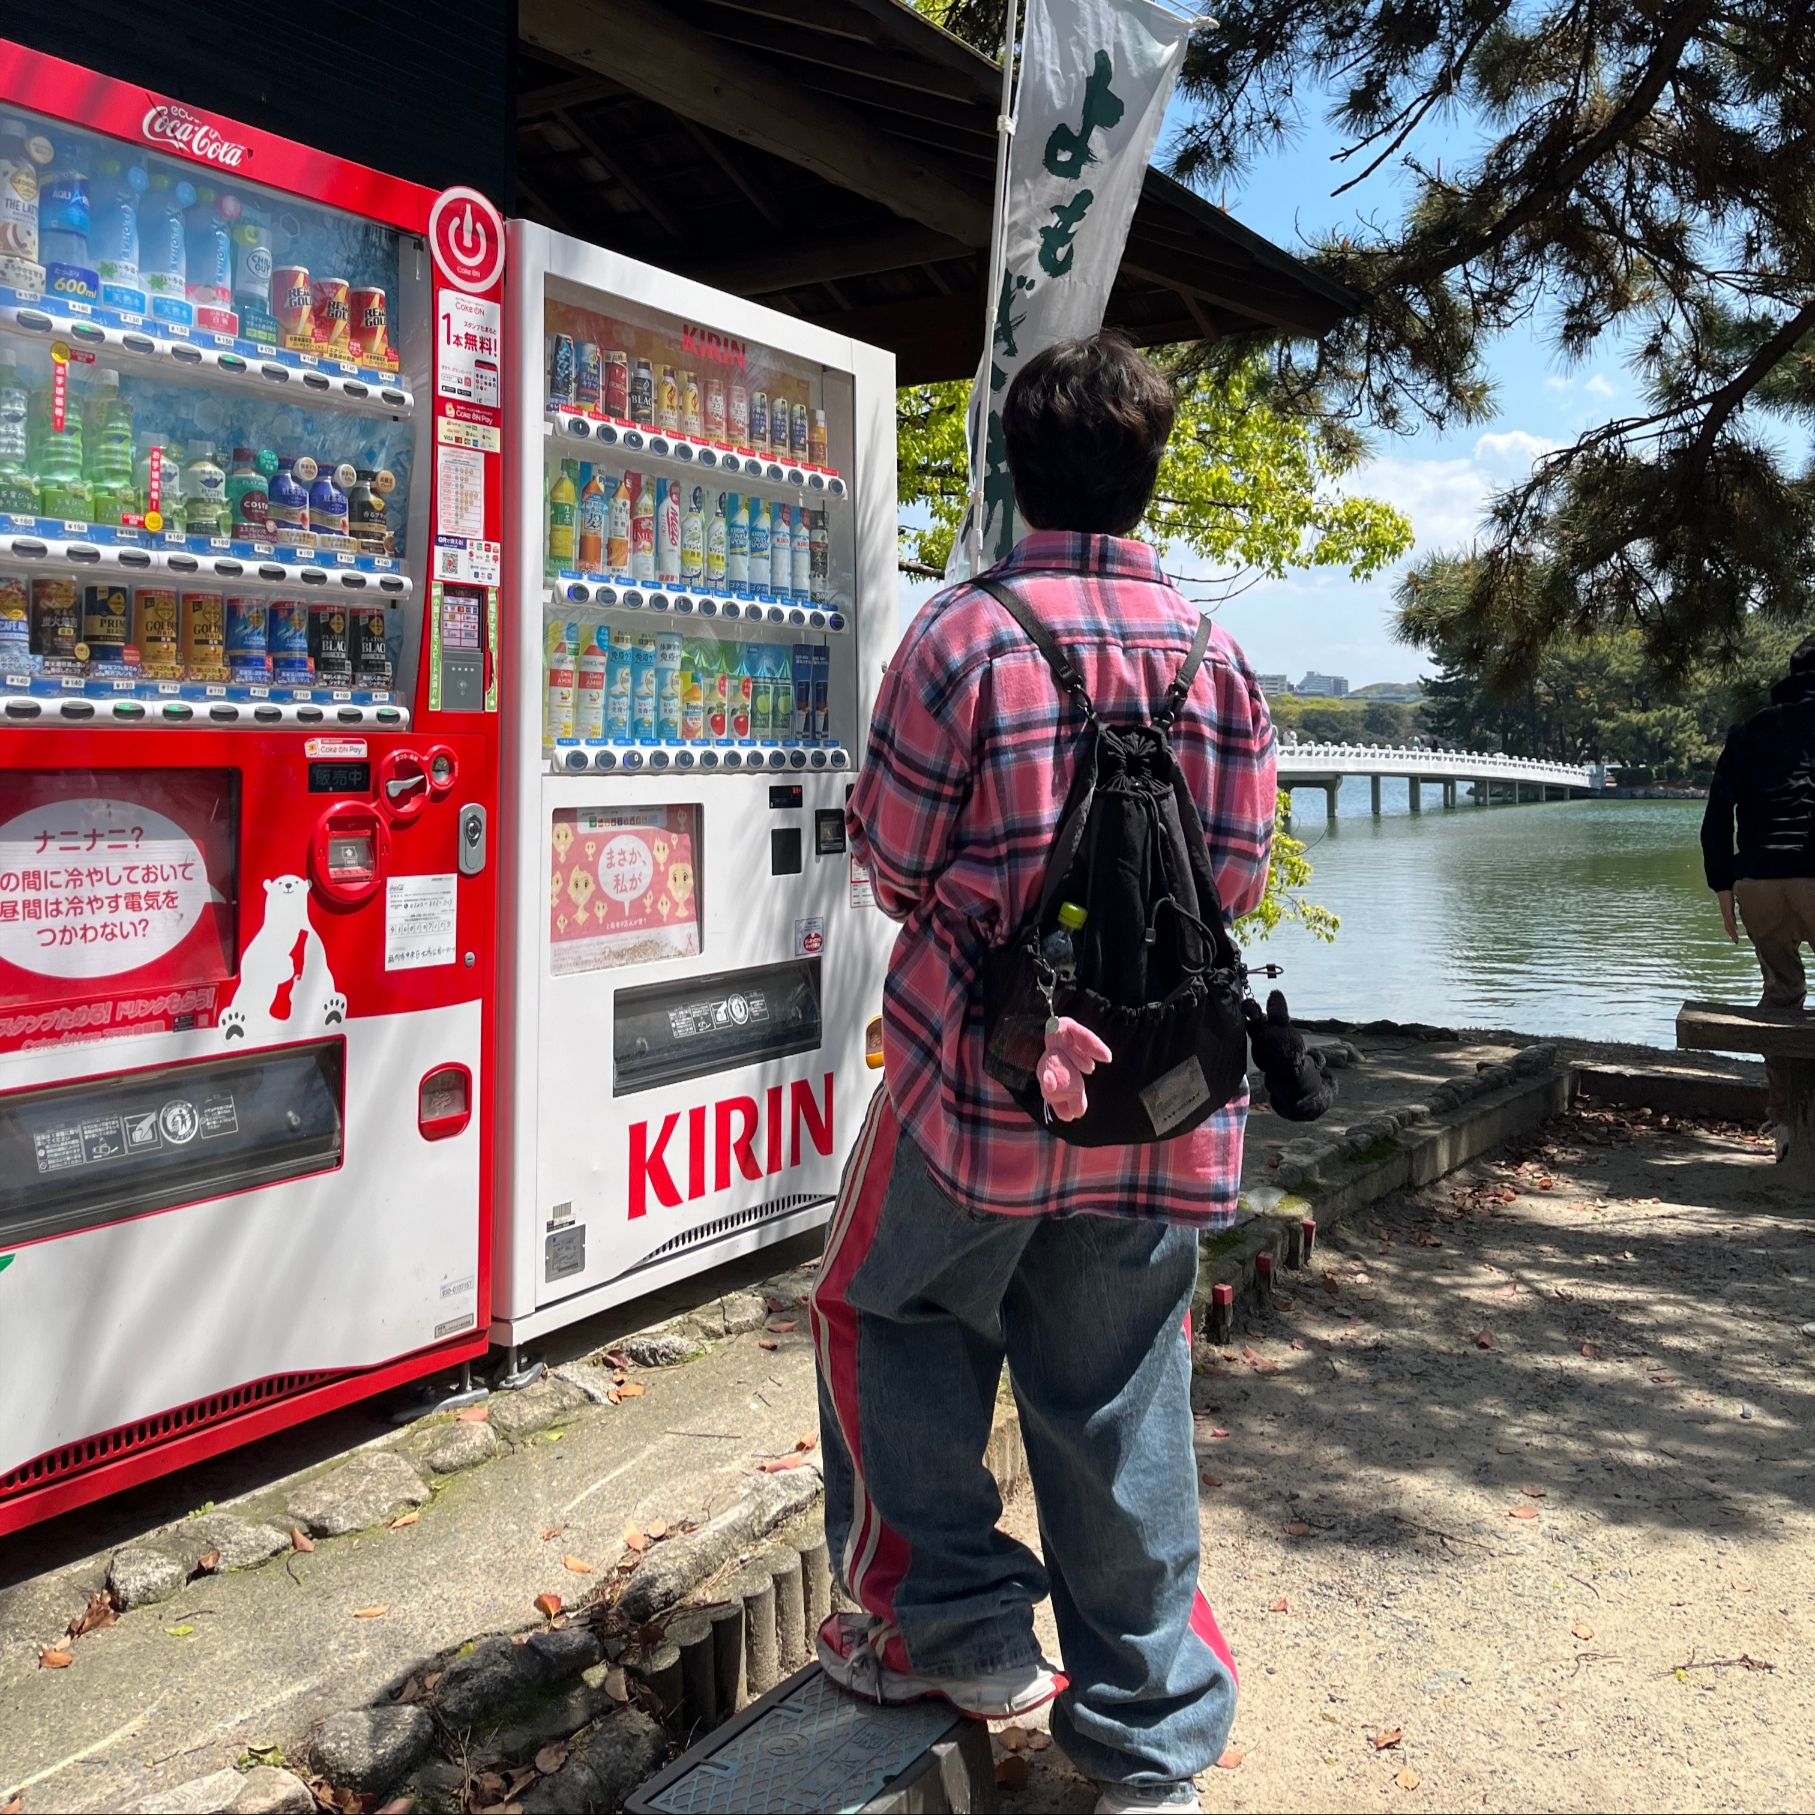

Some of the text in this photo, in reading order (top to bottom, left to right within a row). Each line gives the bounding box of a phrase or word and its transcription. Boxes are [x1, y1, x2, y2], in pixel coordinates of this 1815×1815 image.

[142, 105, 242, 167] Coca-Cola
[255, 263, 271, 275] OUT
[54, 278, 97, 299] 600ml
[455, 302, 473, 312] Coke
[442, 313, 497, 357] 1本無料!
[464, 321, 497, 335] スタンプたまると
[682, 324, 746, 369] KIRIN
[244, 501, 268, 510] COSTA
[564, 505, 571, 524] 生茶
[350, 746, 363, 755] Pay
[315, 769, 362, 787] 販売中
[34, 826, 144, 854] ナニナニ?
[606, 847, 647, 869] まさか、
[1, 863, 195, 893] の間に冷やしておいて
[613, 871, 642, 894] 私が
[0, 890, 179, 923] 昼間は冷やす電気を
[37, 918, 150, 947] つかわない?
[0, 987, 216, 1037] スタンプためる! ドリンクもらう!
[628, 1071, 834, 1221] KIRIN
